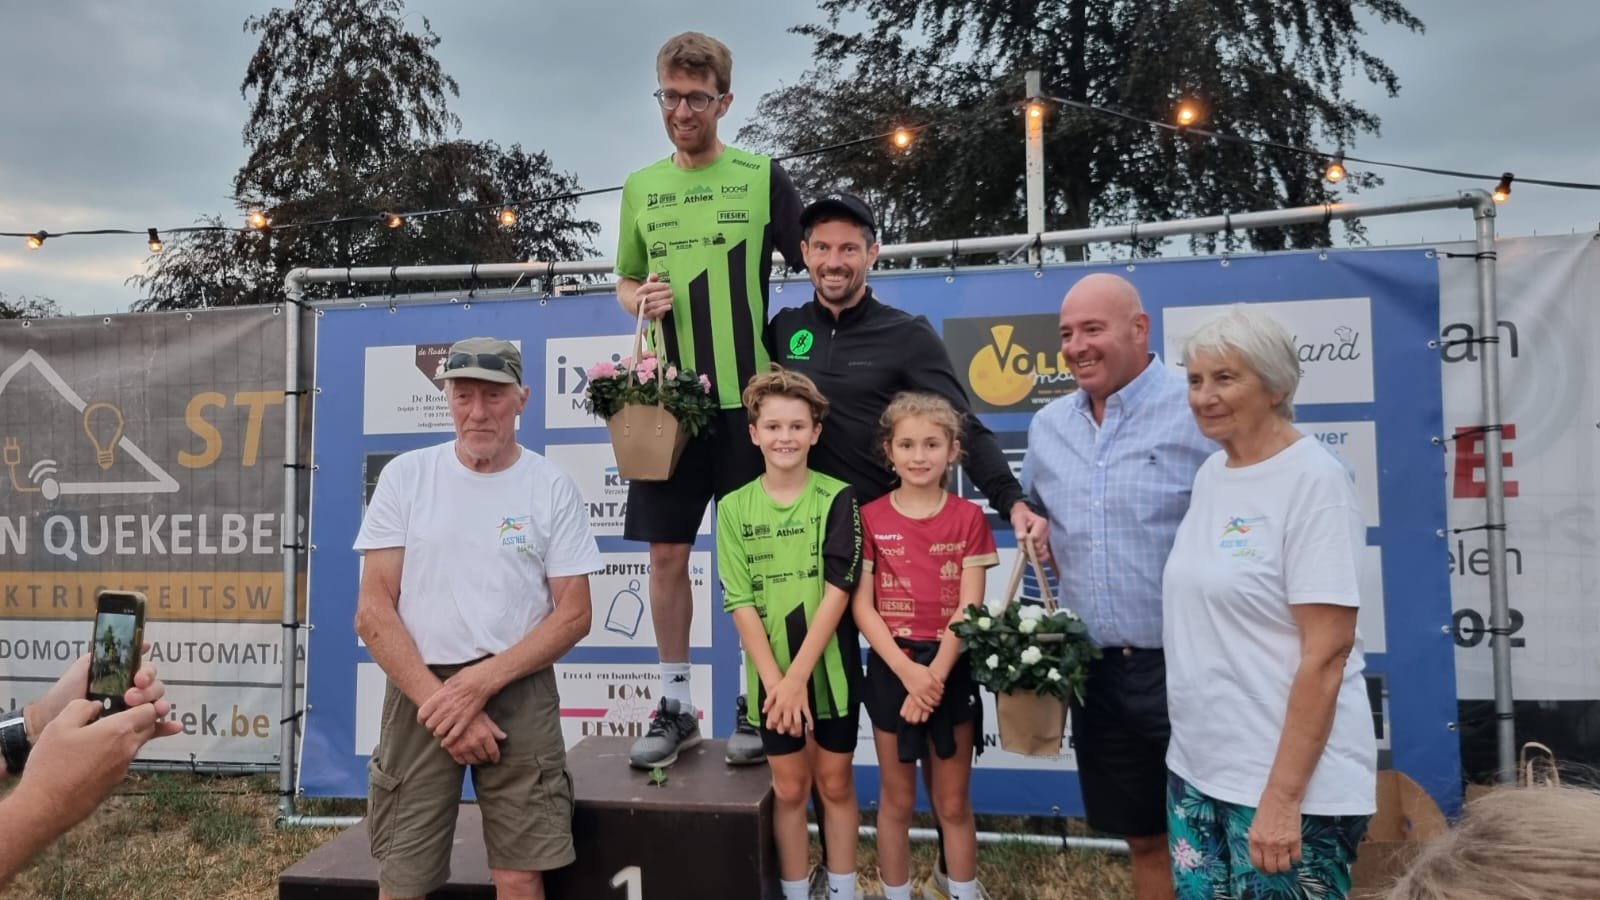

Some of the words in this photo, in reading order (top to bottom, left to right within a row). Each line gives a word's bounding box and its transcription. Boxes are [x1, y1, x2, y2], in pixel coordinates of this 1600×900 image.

[683, 194, 714, 204] Athlex
[720, 212, 746, 220] FIESIEK
[1292, 331, 1360, 362] and
[177, 389, 311, 469] ST
[776, 527, 805, 537] Athlex
[603, 683, 652, 701] TOM
